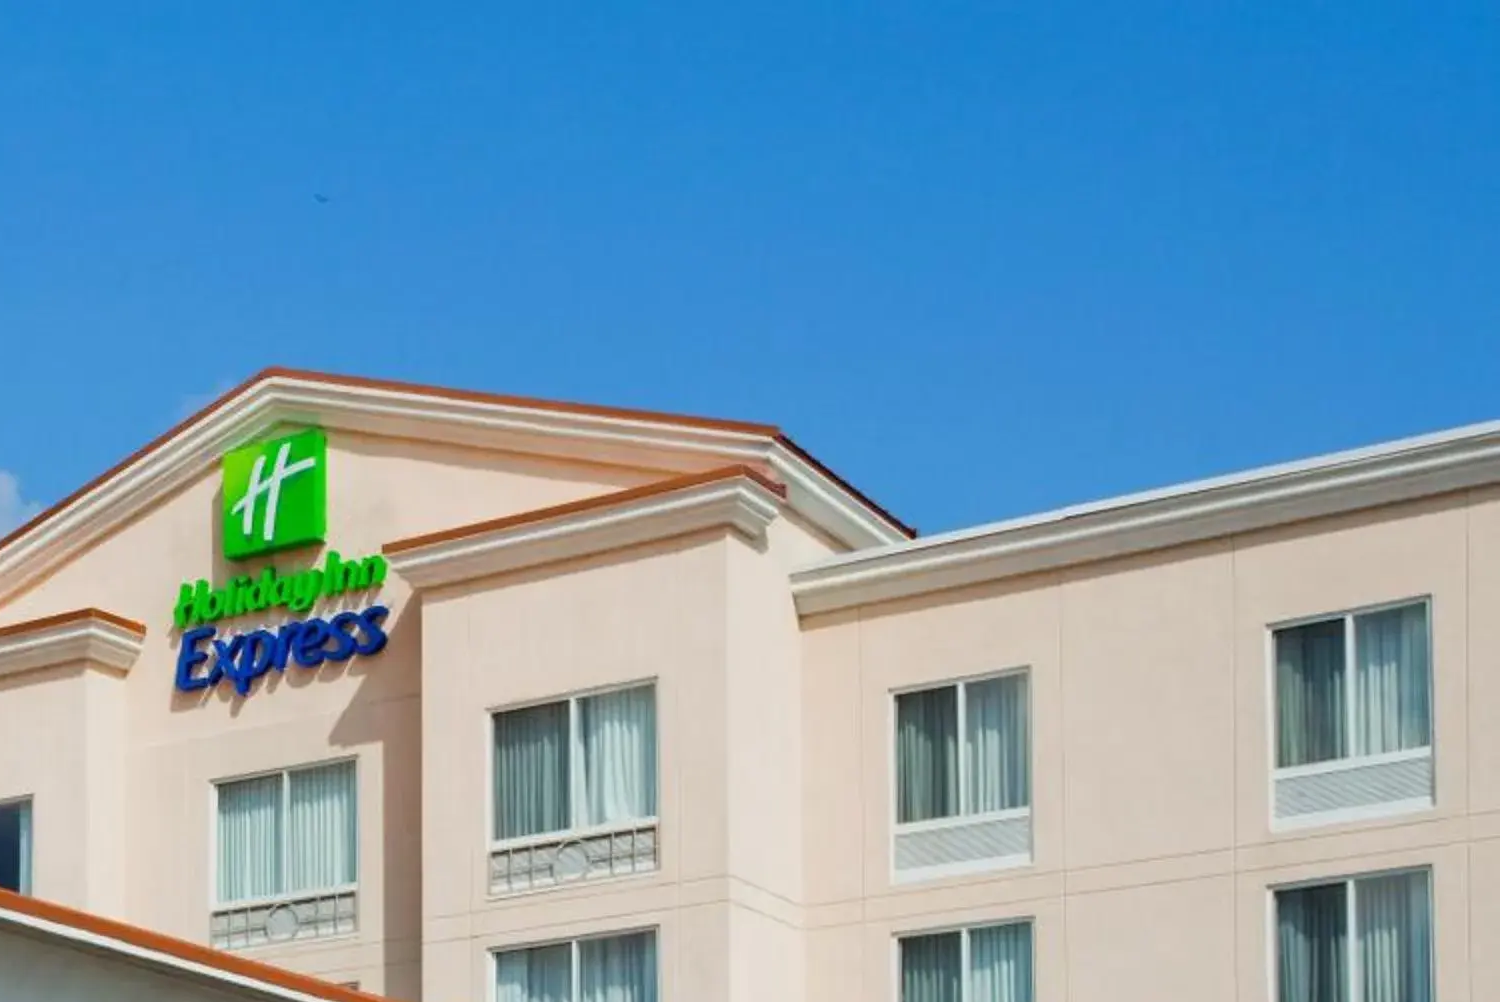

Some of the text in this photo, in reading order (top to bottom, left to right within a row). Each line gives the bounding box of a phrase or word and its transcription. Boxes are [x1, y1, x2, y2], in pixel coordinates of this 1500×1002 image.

[231, 442, 316, 541] H
[174, 550, 388, 629] Holiday Inn
[175, 605, 390, 696] Express
